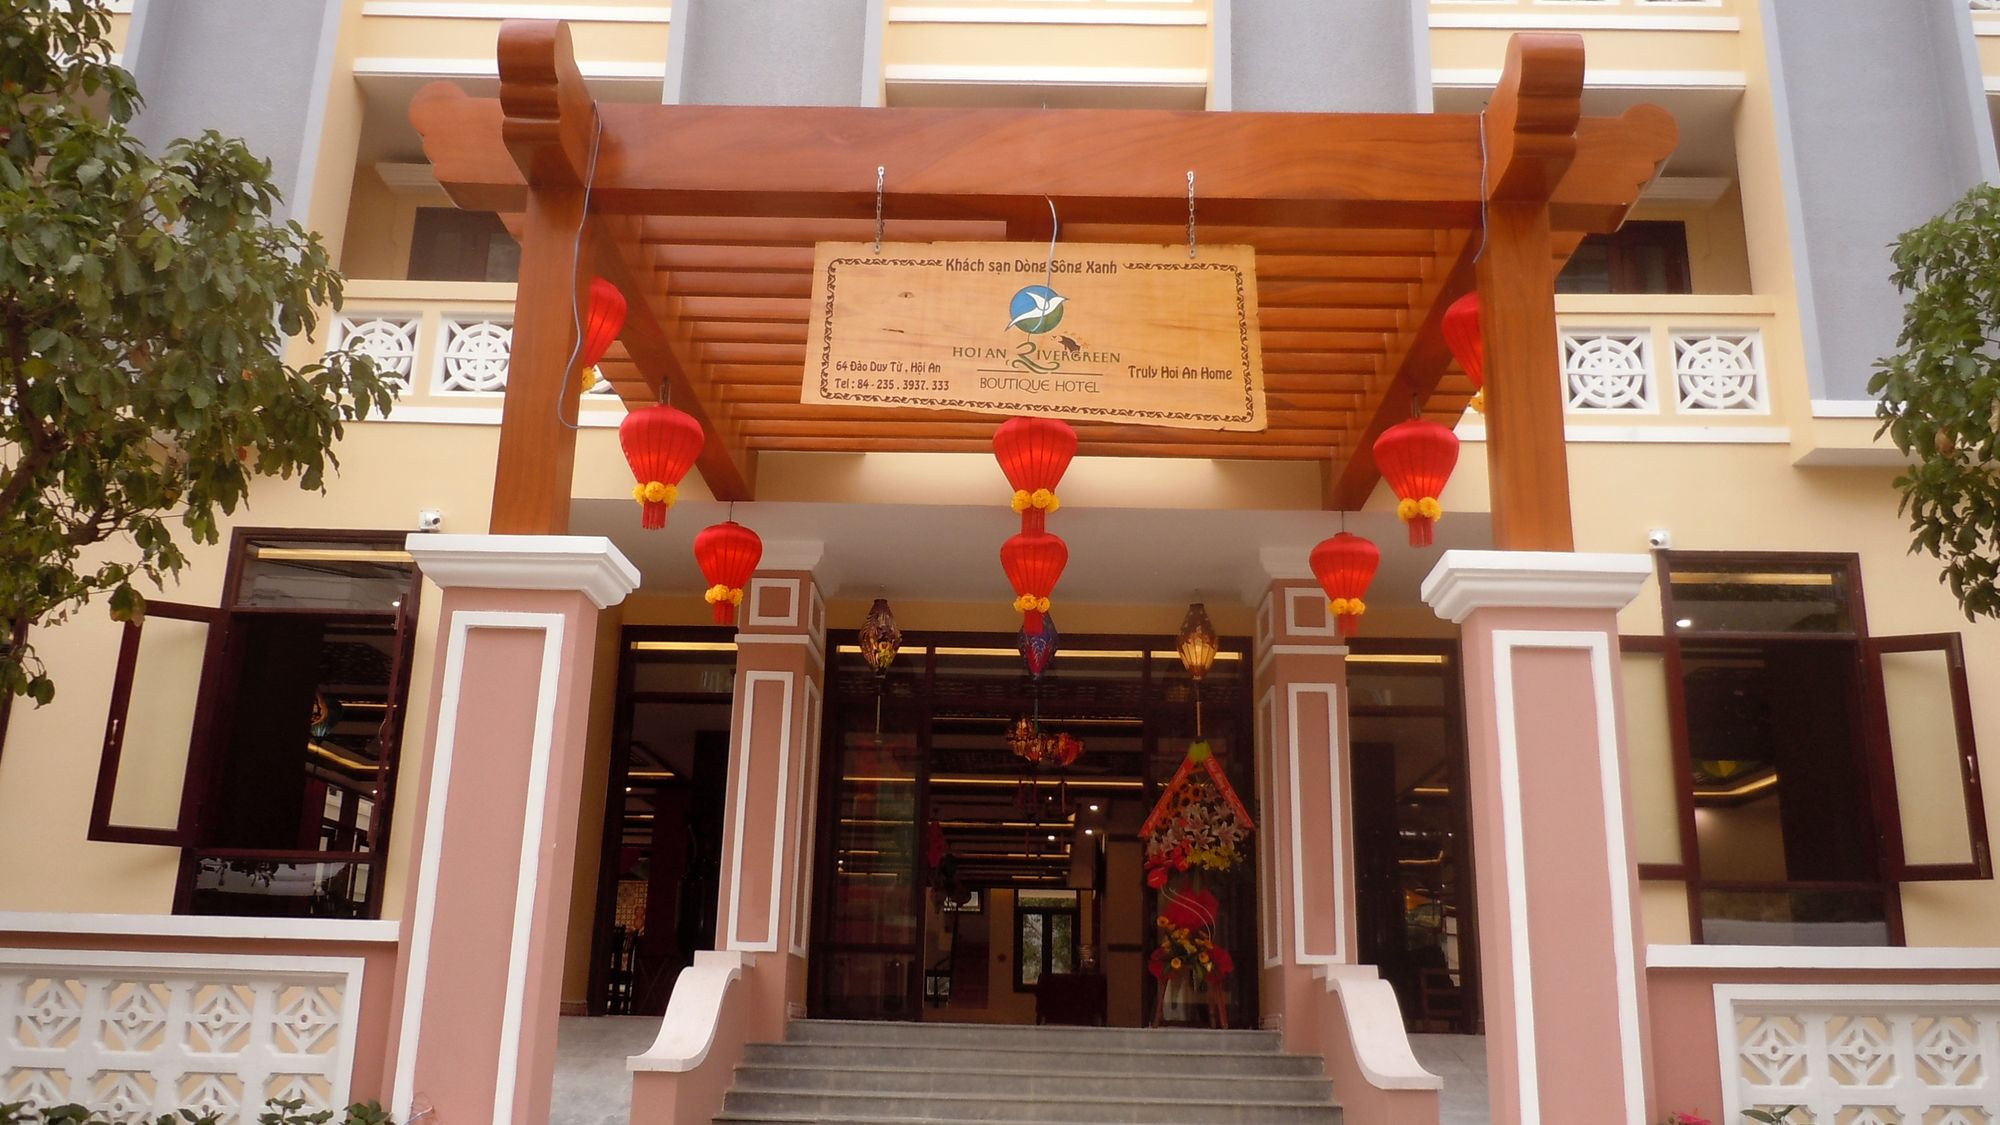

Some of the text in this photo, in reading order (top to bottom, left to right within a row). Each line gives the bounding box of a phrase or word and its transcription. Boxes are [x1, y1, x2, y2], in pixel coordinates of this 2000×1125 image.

[945, 257, 1117, 275] Khách sạn Dòng Sông Xanh
[952, 346, 982, 359] HOI
[985, 348, 1007, 359] AN
[835, 360, 848, 372] 64
[870, 361, 888, 372] Duy
[910, 361, 926, 376] Hội
[928, 362, 941, 373] An
[1128, 365, 1233, 380] Truly Hoi An Home
[931, 380, 950, 391] 333
[980, 377, 1100, 394] BOUTIQUE HOTEL
